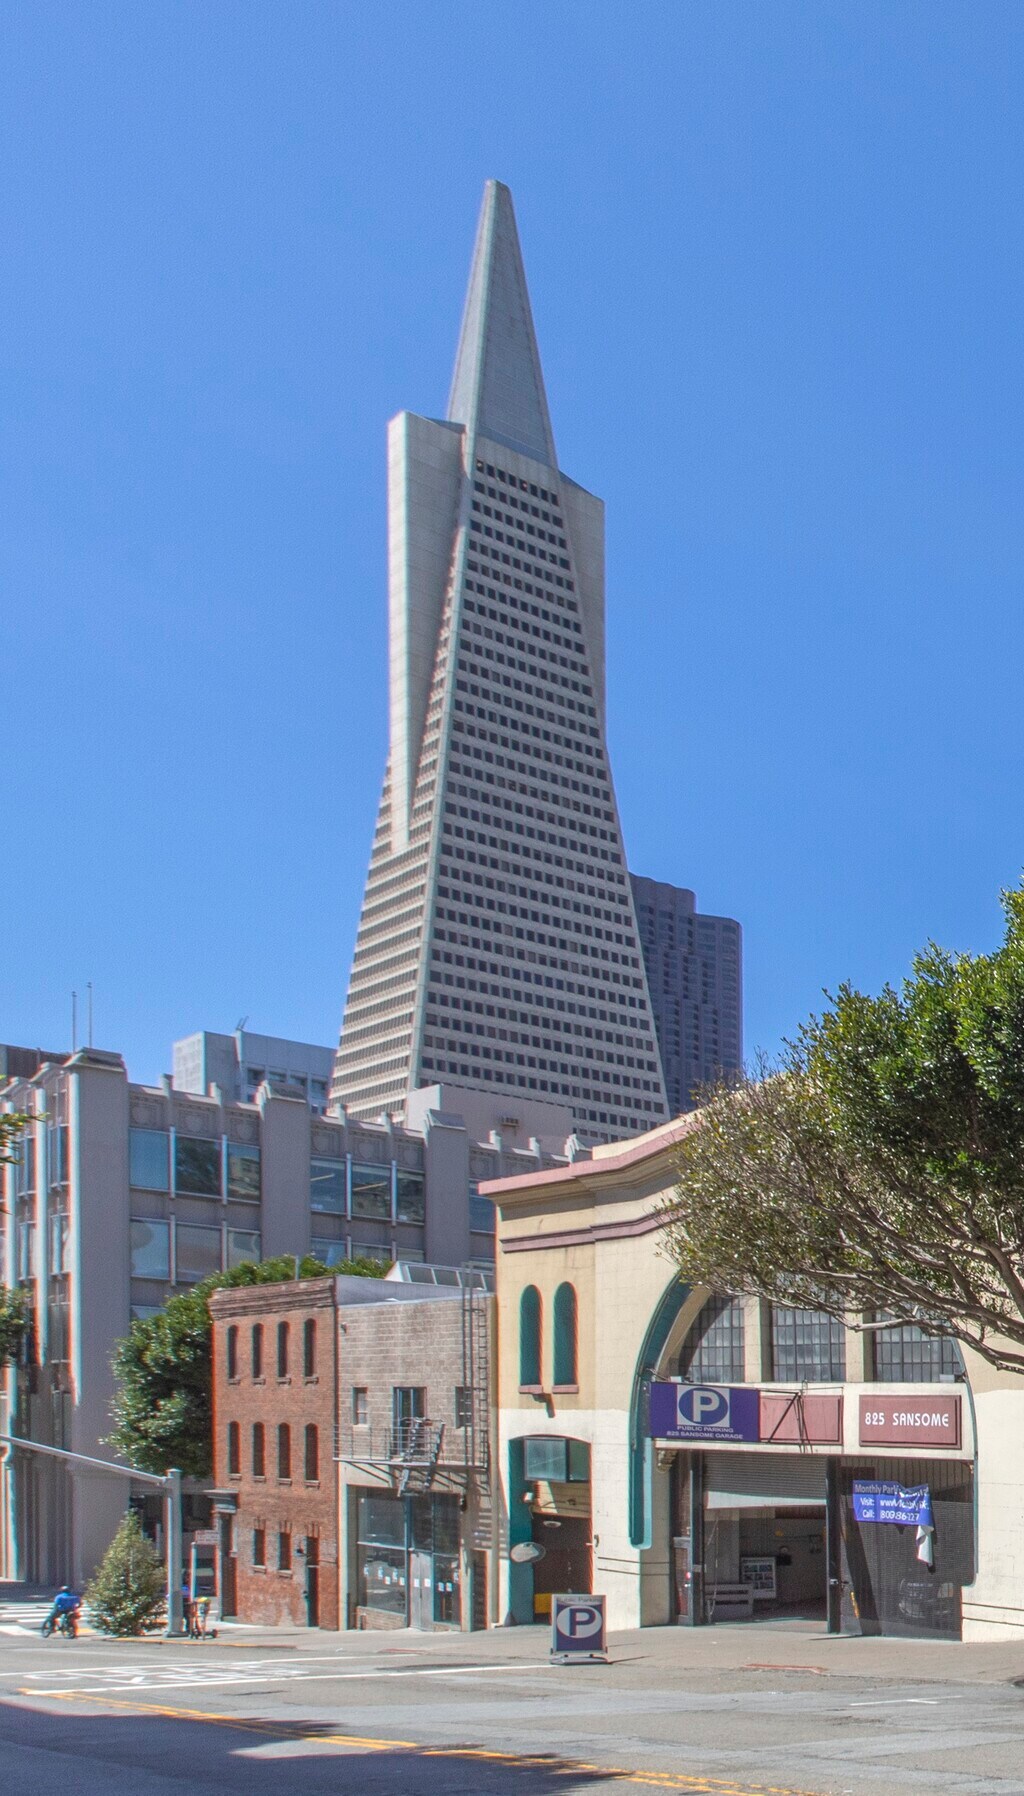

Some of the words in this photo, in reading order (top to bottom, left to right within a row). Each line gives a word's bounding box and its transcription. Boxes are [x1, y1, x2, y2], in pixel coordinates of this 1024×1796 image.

[693, 1390, 720, 1422] P
[865, 1412, 885, 1426] 825
[892, 1412, 949, 1427] SANSOME
[855, 1484, 882, 1496] Monthly
[569, 1607, 597, 1636] P
